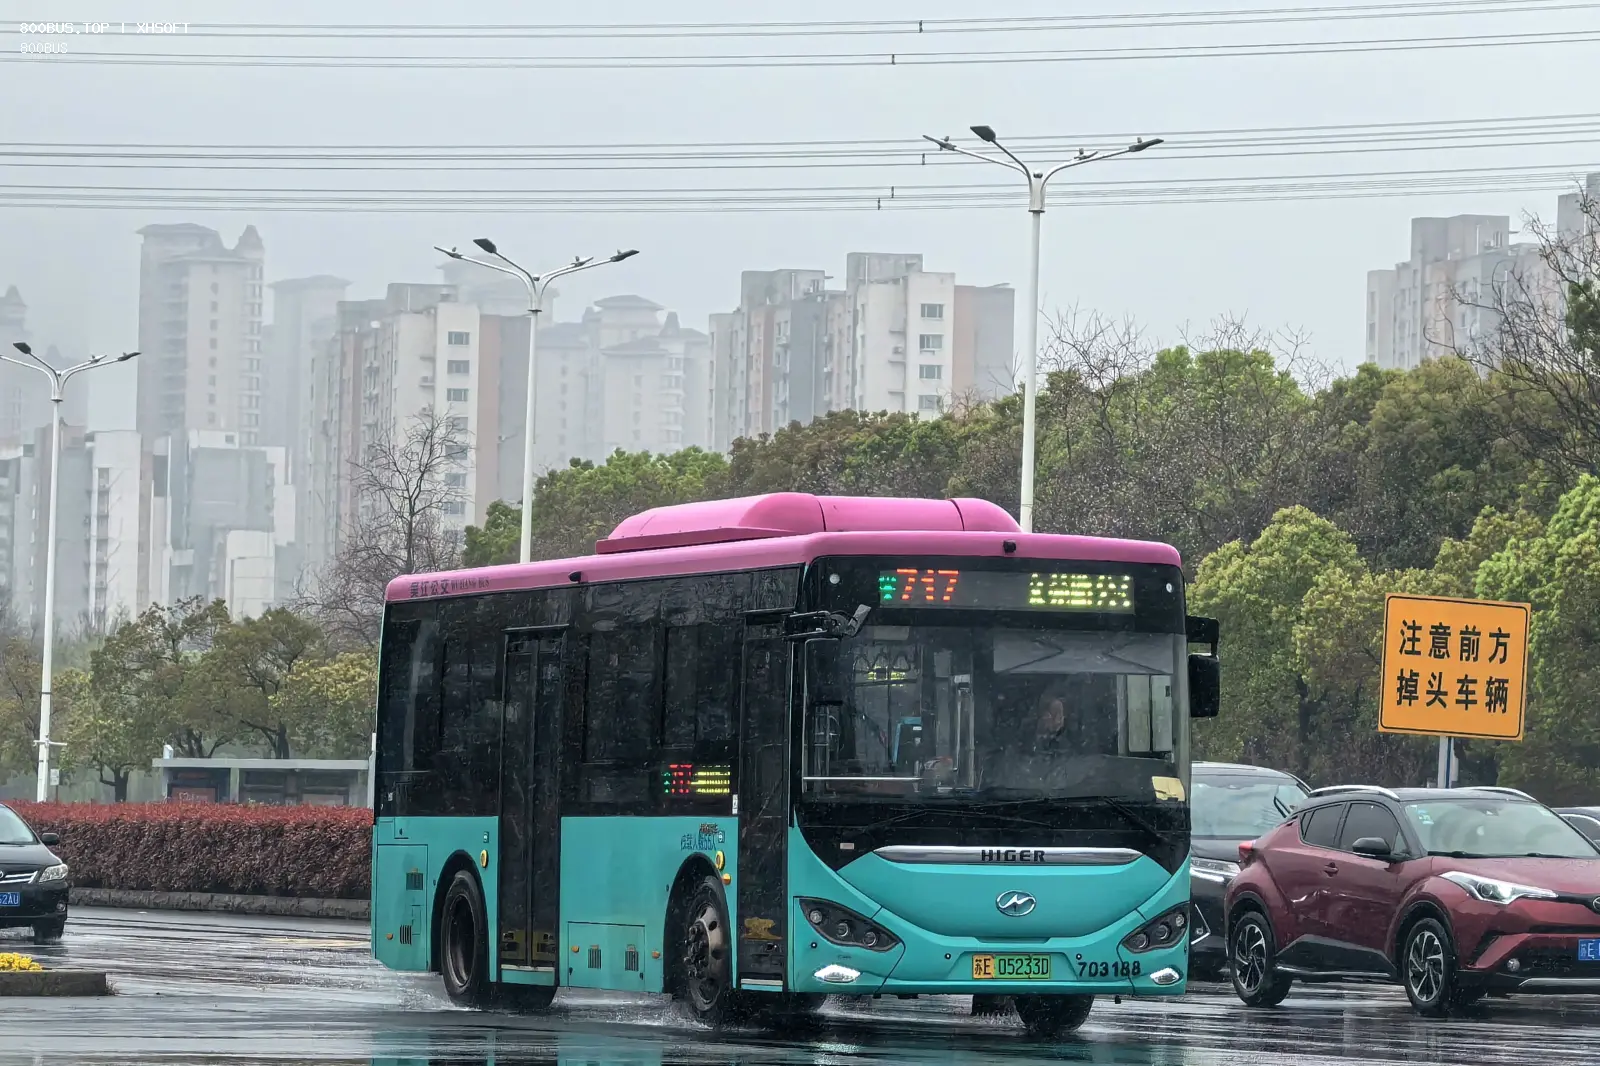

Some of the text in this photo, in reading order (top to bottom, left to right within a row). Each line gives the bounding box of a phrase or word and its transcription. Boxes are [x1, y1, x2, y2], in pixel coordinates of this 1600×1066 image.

[1399, 619, 1511, 665] 注意前方
[1396, 668, 1509, 714] 掉头车辆
[981, 849, 1046, 862] HIGER
[0, 894, 19, 905] 2AU
[1077, 961, 1142, 978] 703188
